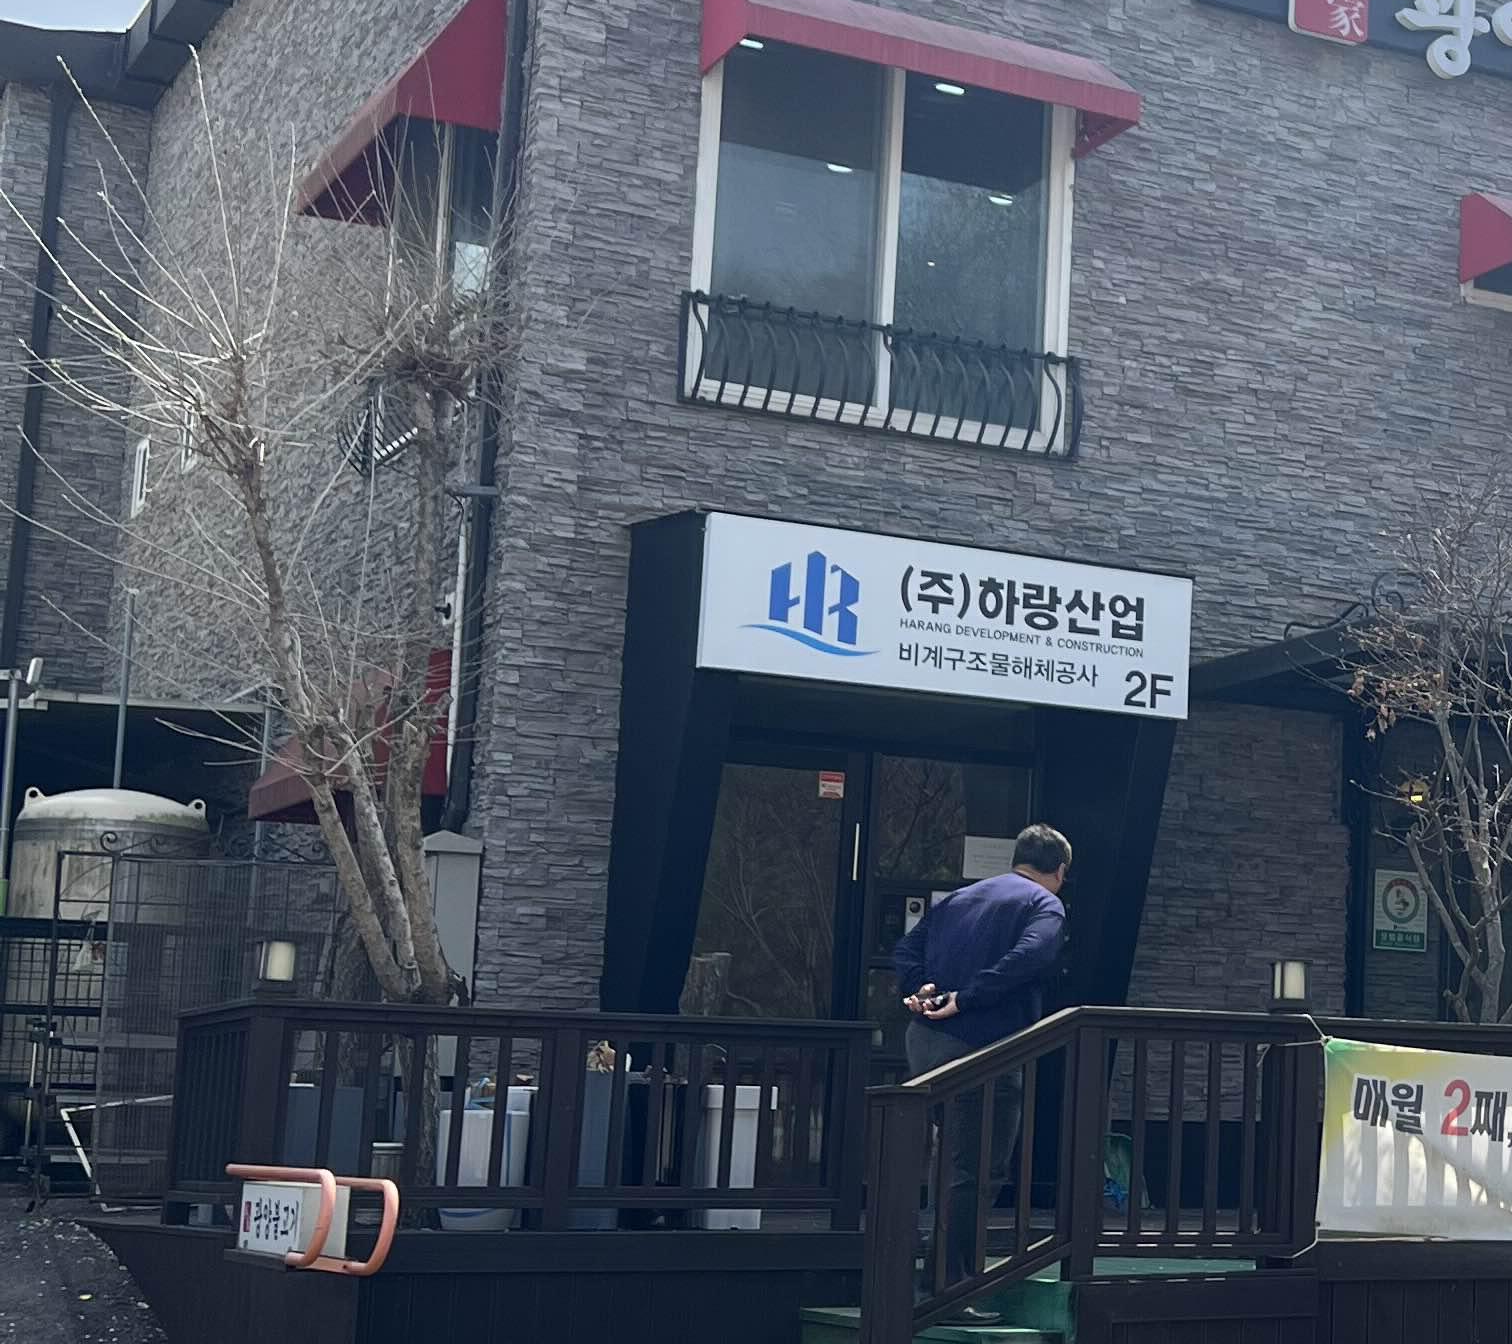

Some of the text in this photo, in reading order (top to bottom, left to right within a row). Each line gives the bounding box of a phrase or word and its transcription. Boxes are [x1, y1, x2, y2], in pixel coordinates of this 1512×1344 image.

[900, 618, 1144, 659] HARANG DEVELOPMENT & CONSTRUCTION
[899, 642, 1099, 688] 비계구조물해체공사
[1123, 669, 1175, 710] 2F
[1353, 1077, 1425, 1136] 매월
